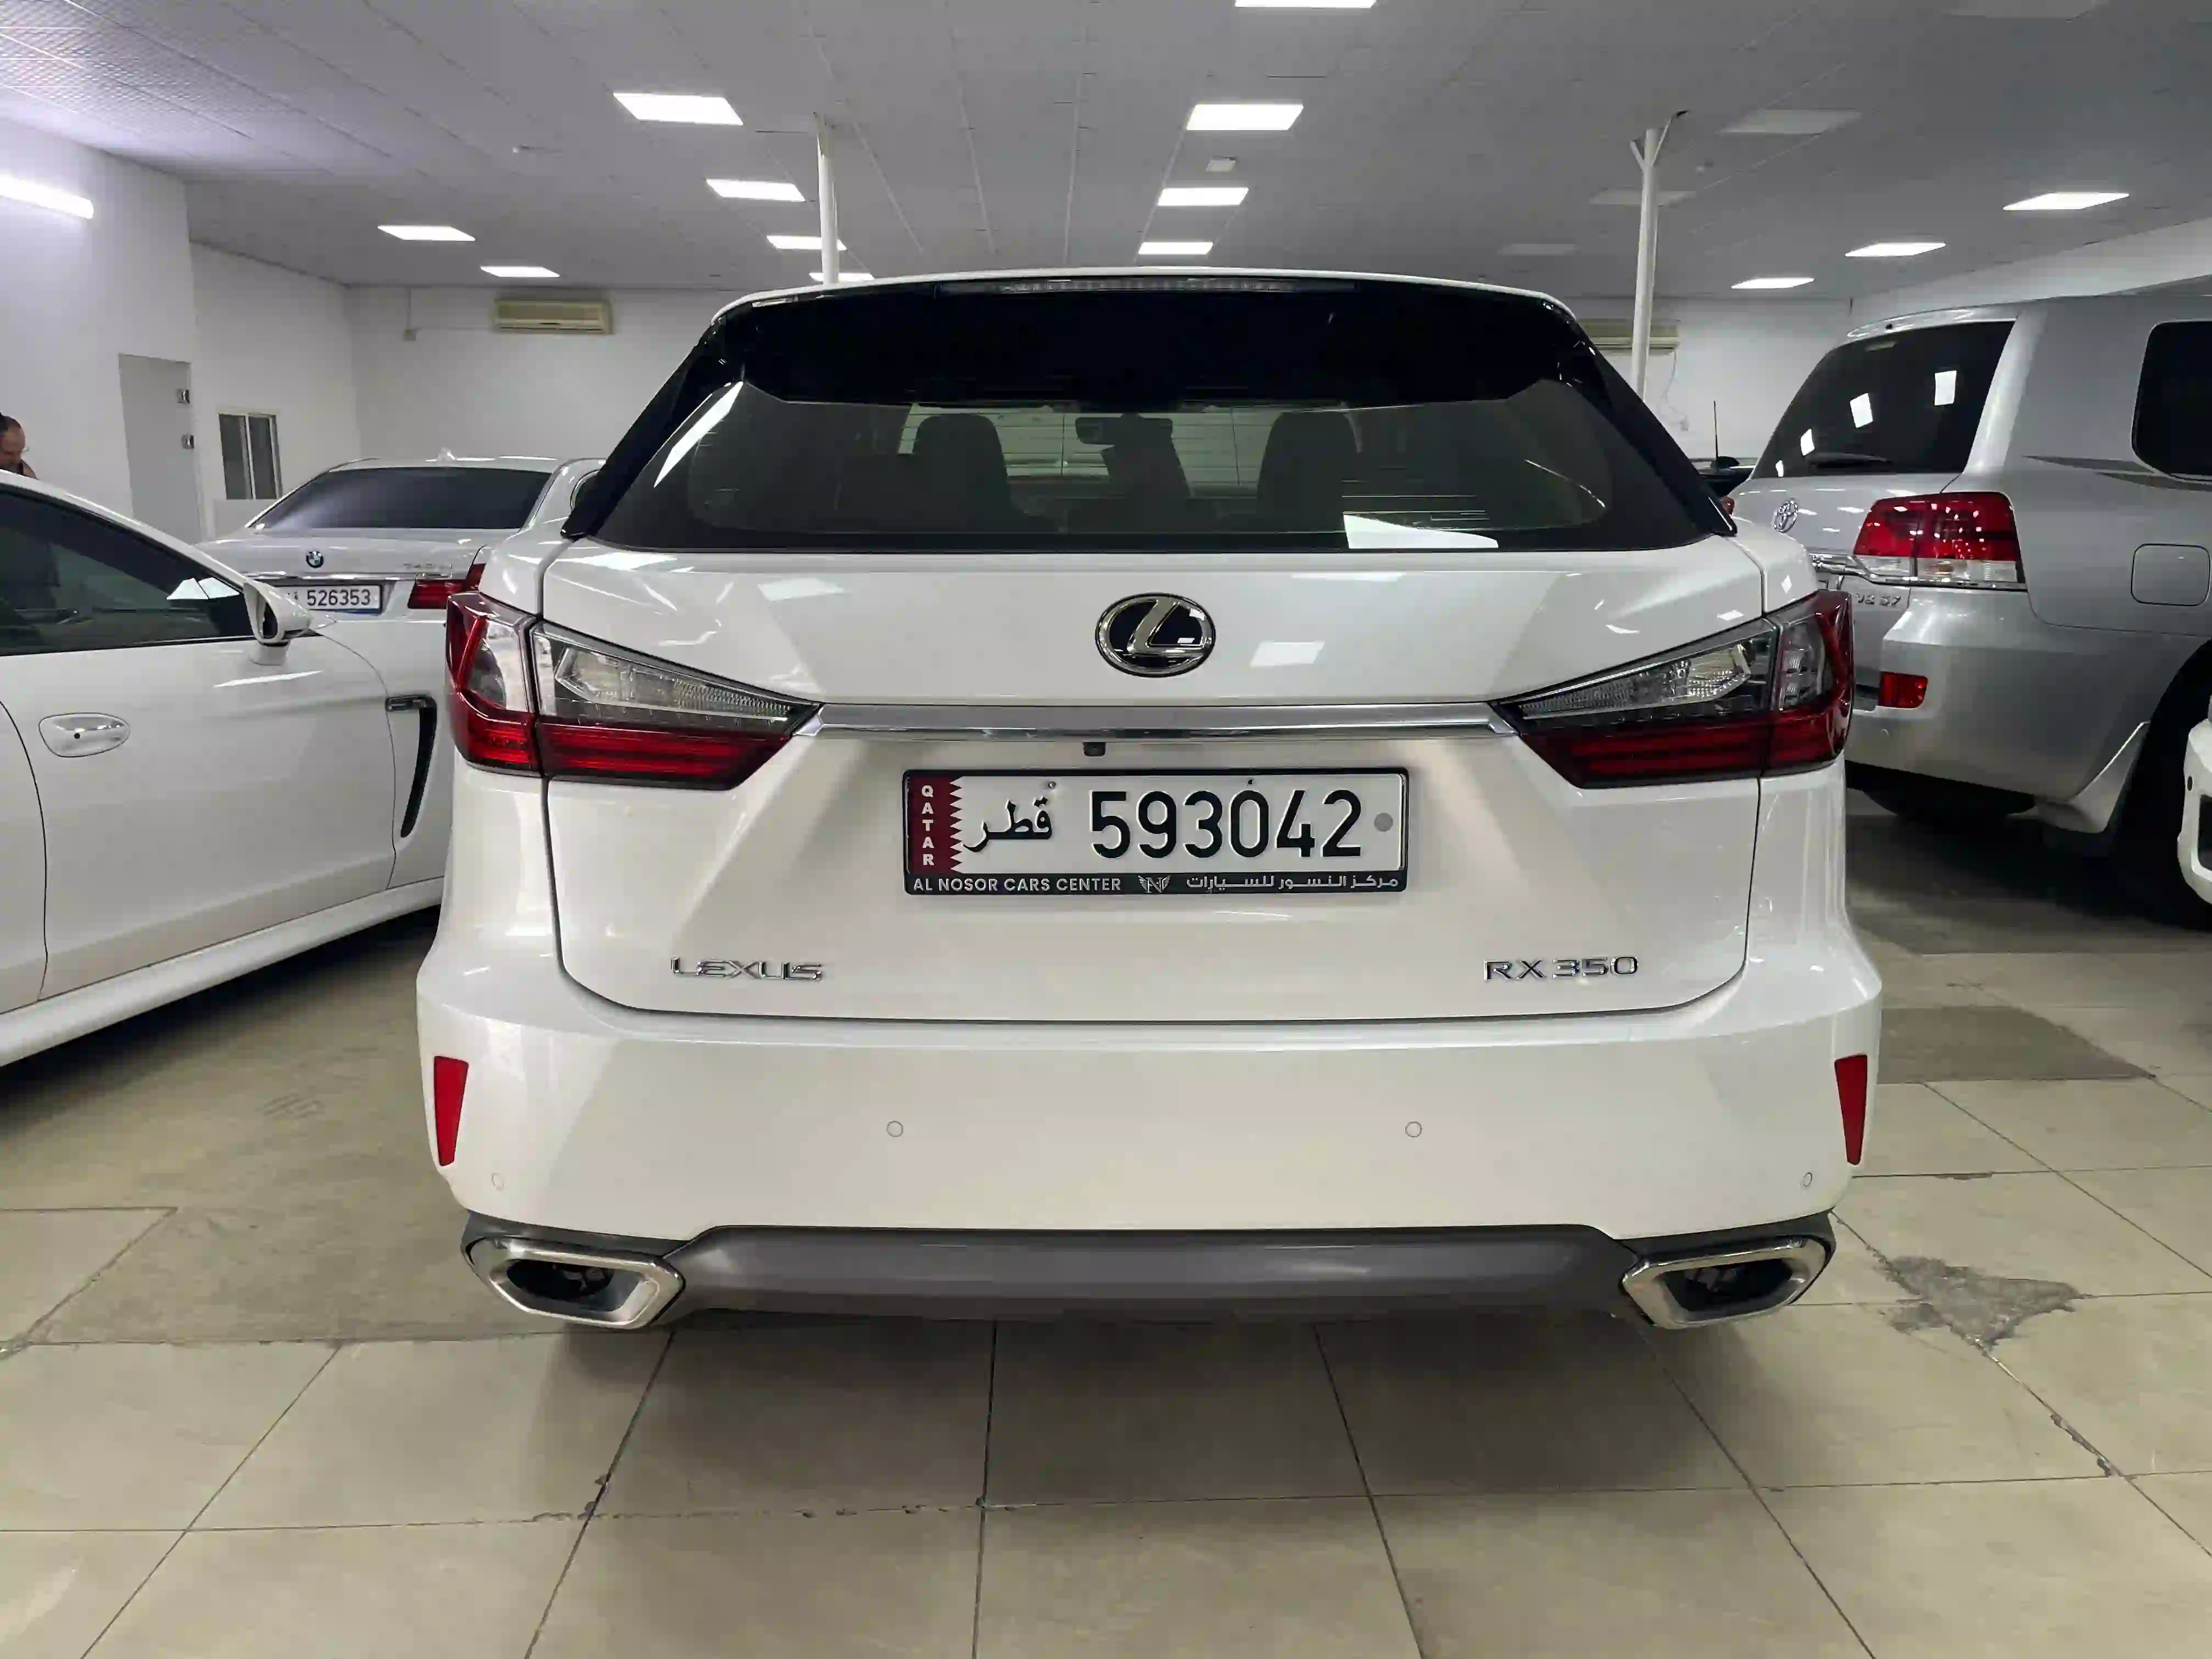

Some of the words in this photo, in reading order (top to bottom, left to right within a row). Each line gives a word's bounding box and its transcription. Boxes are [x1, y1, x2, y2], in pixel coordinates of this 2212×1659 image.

[307, 589, 371, 606] 526353
[921, 785, 935, 866] QATAR
[962, 795, 1052, 853] قطر
[1090, 789, 1362, 858] 593042
[914, 878, 933, 891] AL
[939, 878, 998, 892] NOSOR
[1004, 878, 1051, 891] CARS
[1056, 878, 1121, 891] CENTER
[1187, 875, 1274, 891] للسيارات
[1278, 875, 1347, 890] النسور
[1350, 875, 1399, 888] مركز
[671, 956, 822, 981] LEXUS
[1483, 960, 1547, 981] RX
[1552, 956, 1639, 978] 350
